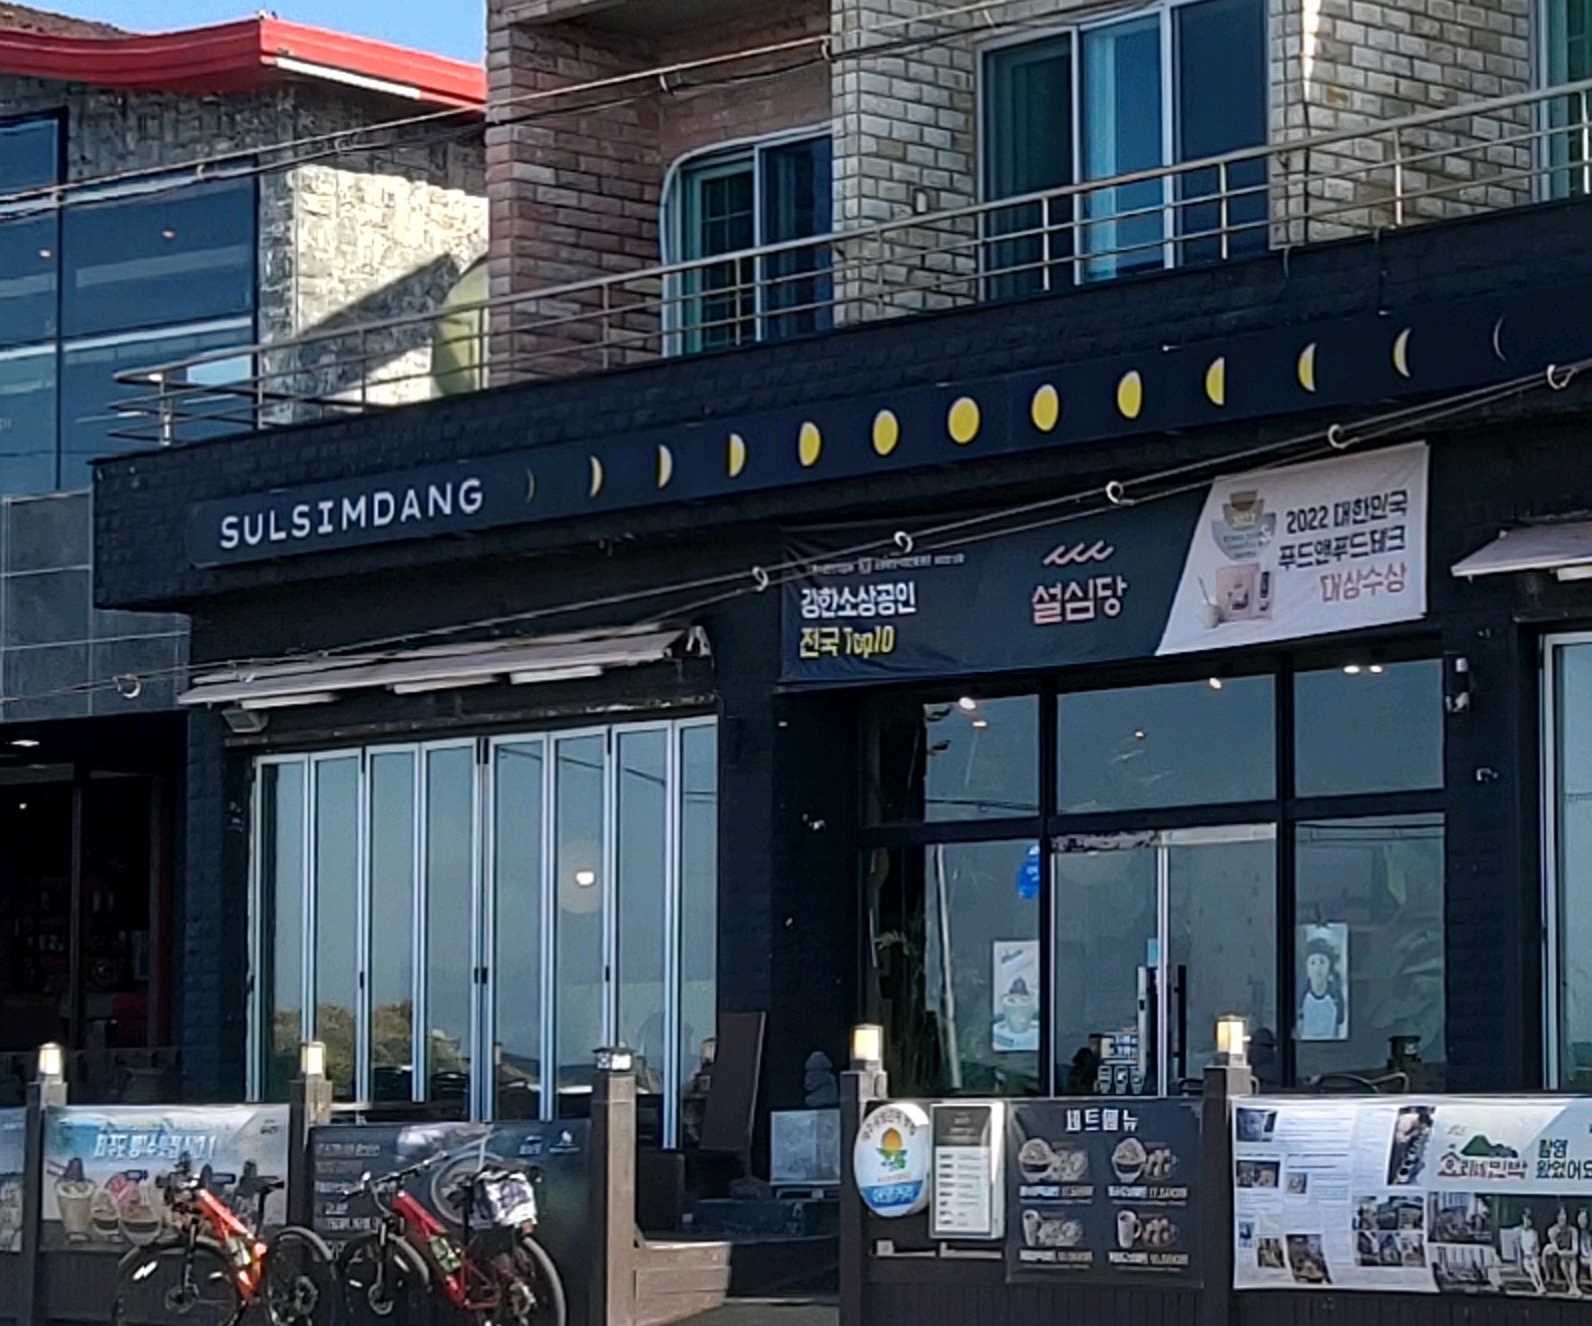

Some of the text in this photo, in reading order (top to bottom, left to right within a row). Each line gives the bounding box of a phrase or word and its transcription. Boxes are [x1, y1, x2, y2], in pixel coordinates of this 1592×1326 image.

[219, 477, 485, 549] SULSIMDANG
[1286, 505, 1330, 535] 2022
[1332, 489, 1408, 528] 대한민국
[800, 581, 917, 619] 강한소상공인
[1031, 576, 1128, 625] 설심당
[1319, 562, 1407, 603] 대상수상
